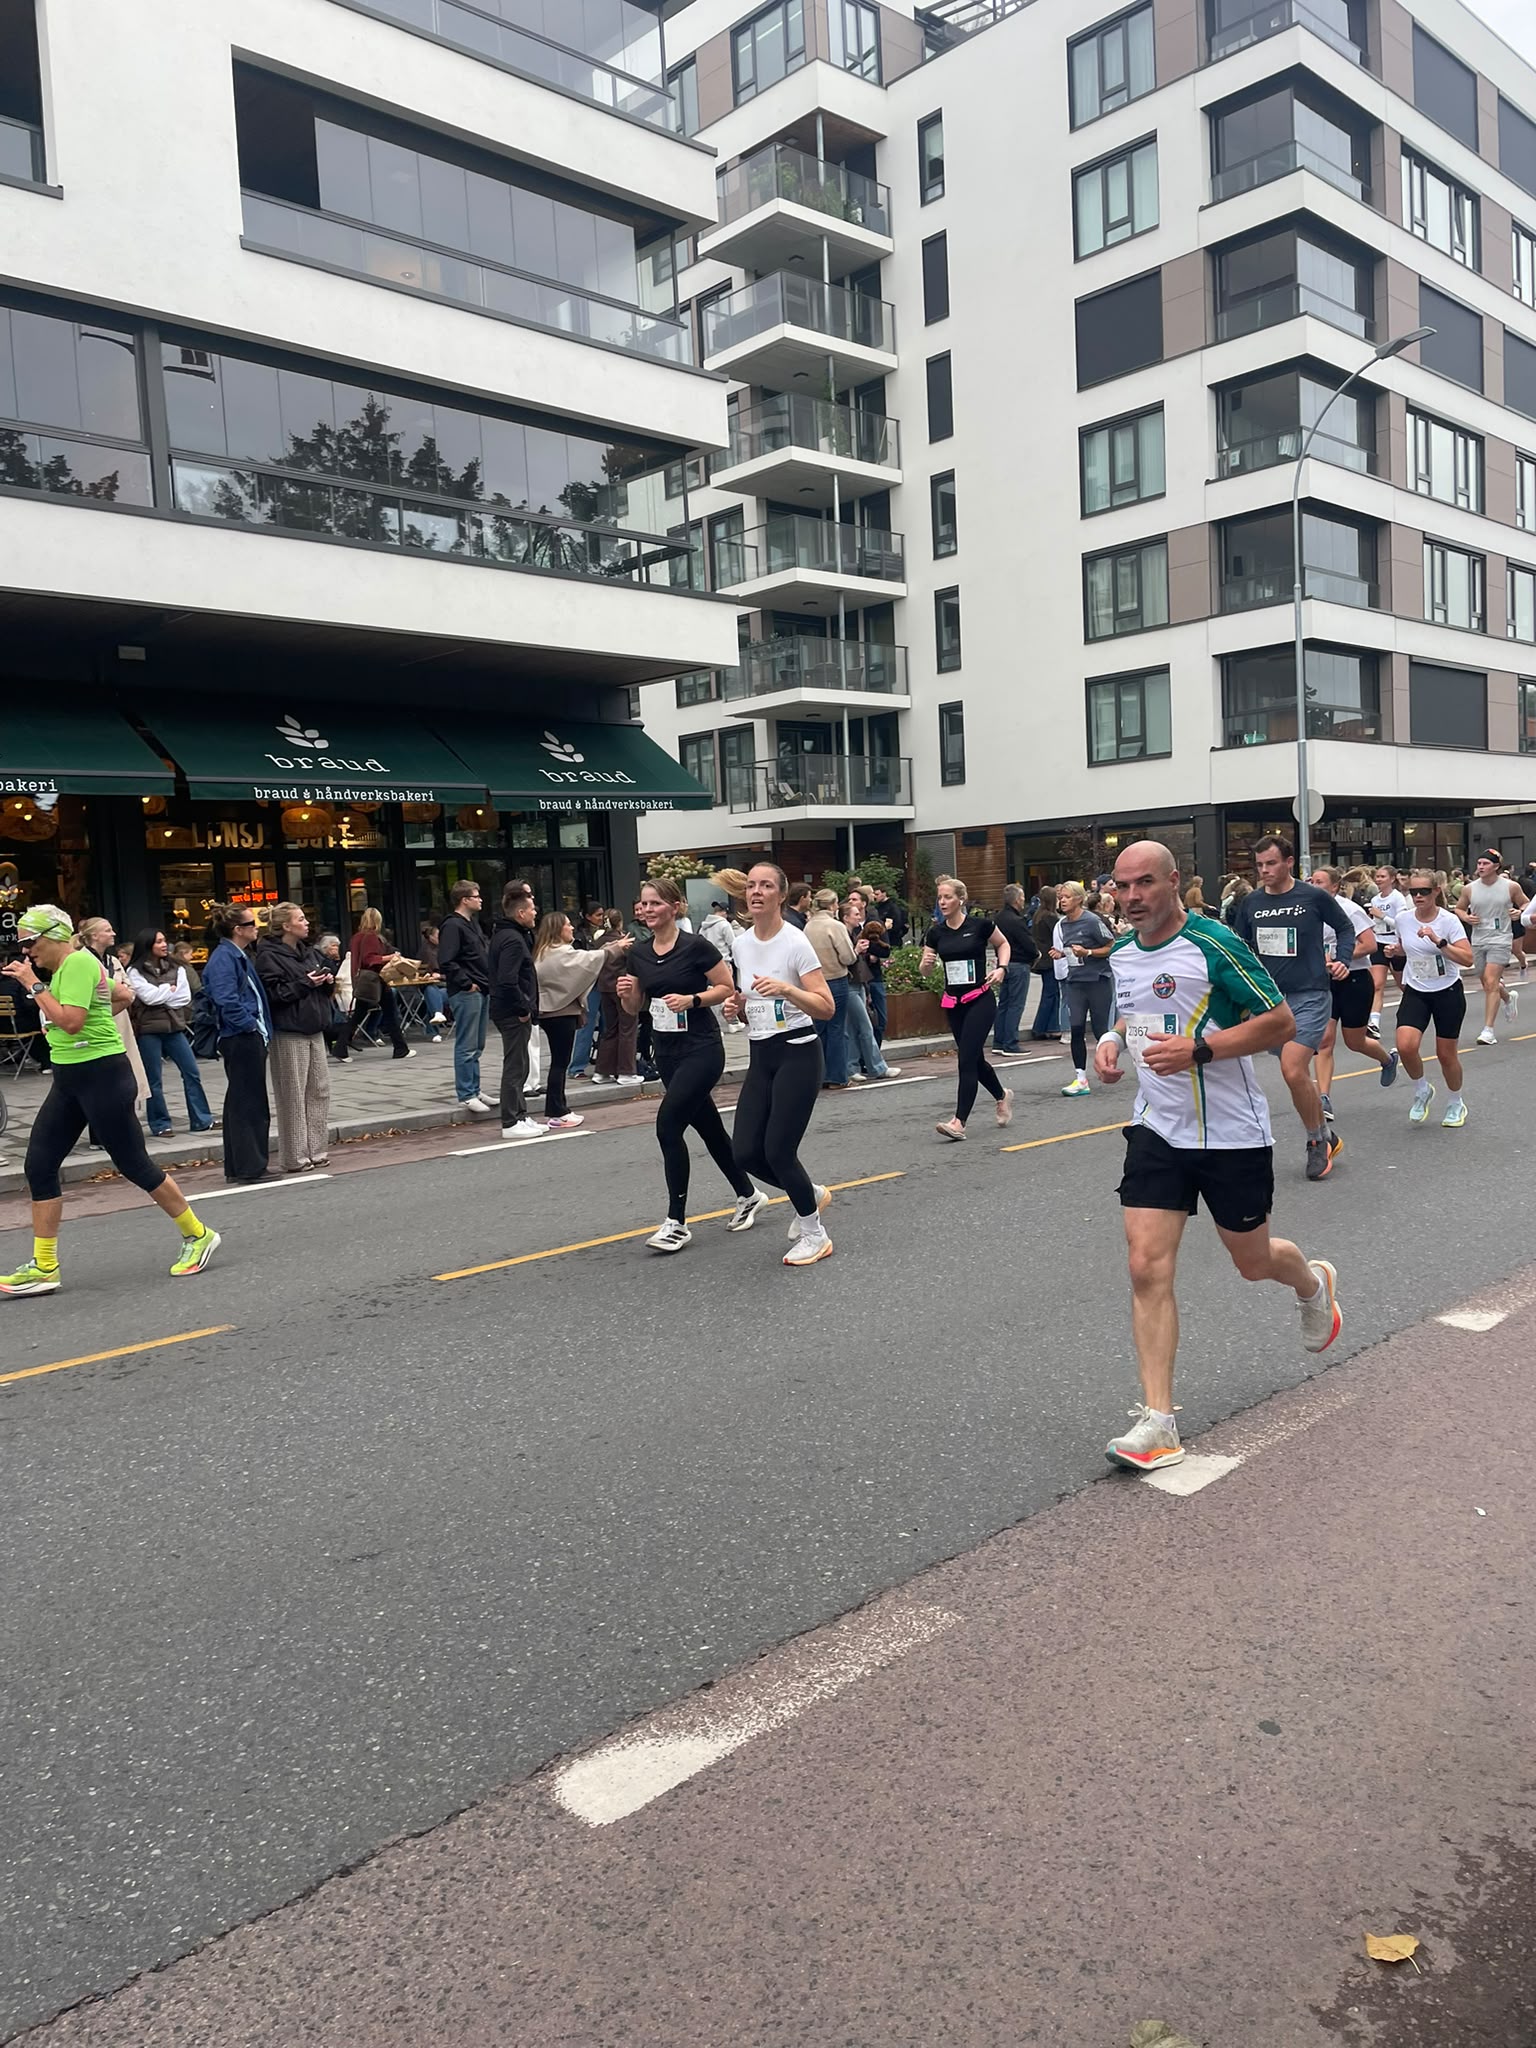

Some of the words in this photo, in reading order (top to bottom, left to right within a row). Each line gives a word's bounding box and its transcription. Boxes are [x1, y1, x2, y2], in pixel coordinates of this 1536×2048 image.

[264, 753, 391, 773] braud
[538, 769, 637, 784] braud
[253, 787, 299, 800] braud
[315, 786, 434, 803] håndverksbakeri
[538, 799, 573, 811] braud
[584, 797, 674, 811] håndverksbakeri
[1254, 907, 1294, 919] CRAFT
[747, 1005, 765, 1014] 28923
